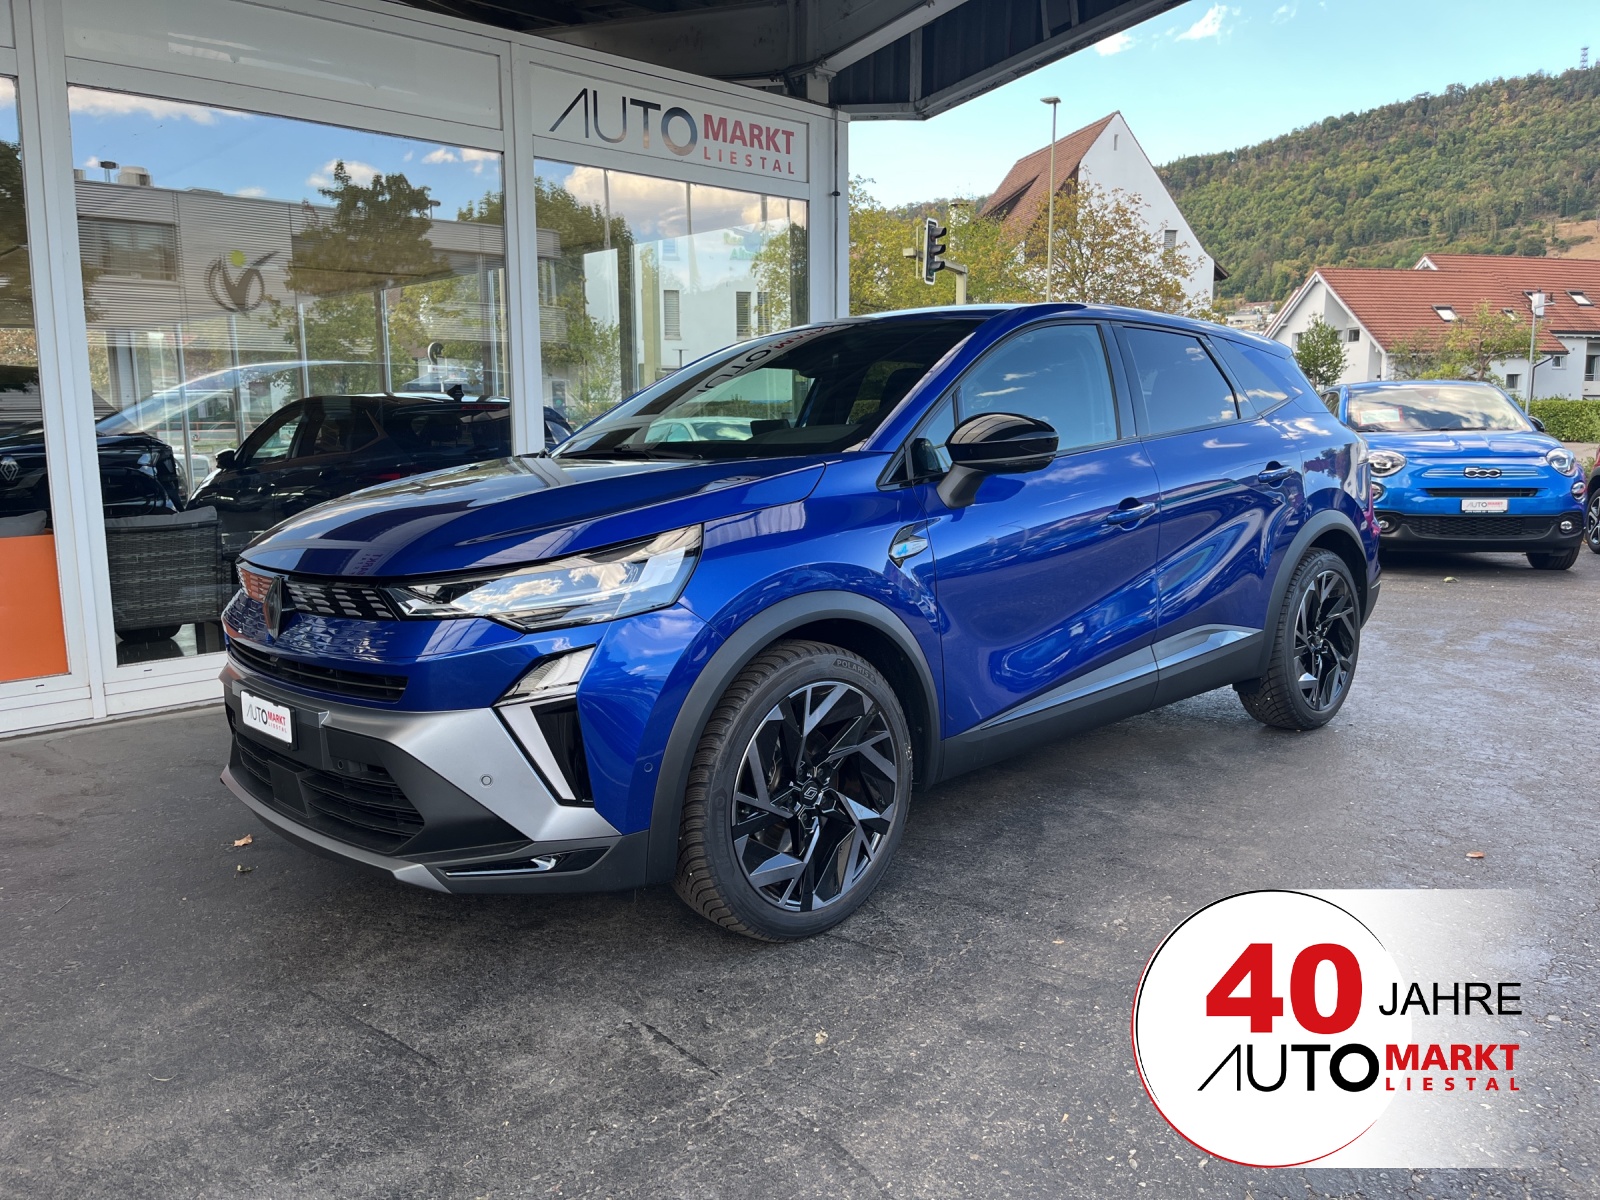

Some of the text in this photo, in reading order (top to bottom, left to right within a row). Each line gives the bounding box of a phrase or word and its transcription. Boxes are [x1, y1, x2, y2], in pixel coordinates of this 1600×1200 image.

[549, 88, 795, 156] AUTO MARKT
[704, 146, 795, 175] LIESTAL
[1464, 467, 1501, 478] 500
[836, 659, 869, 677] POLARIS
[247, 704, 286, 726] AUTO MARKT
